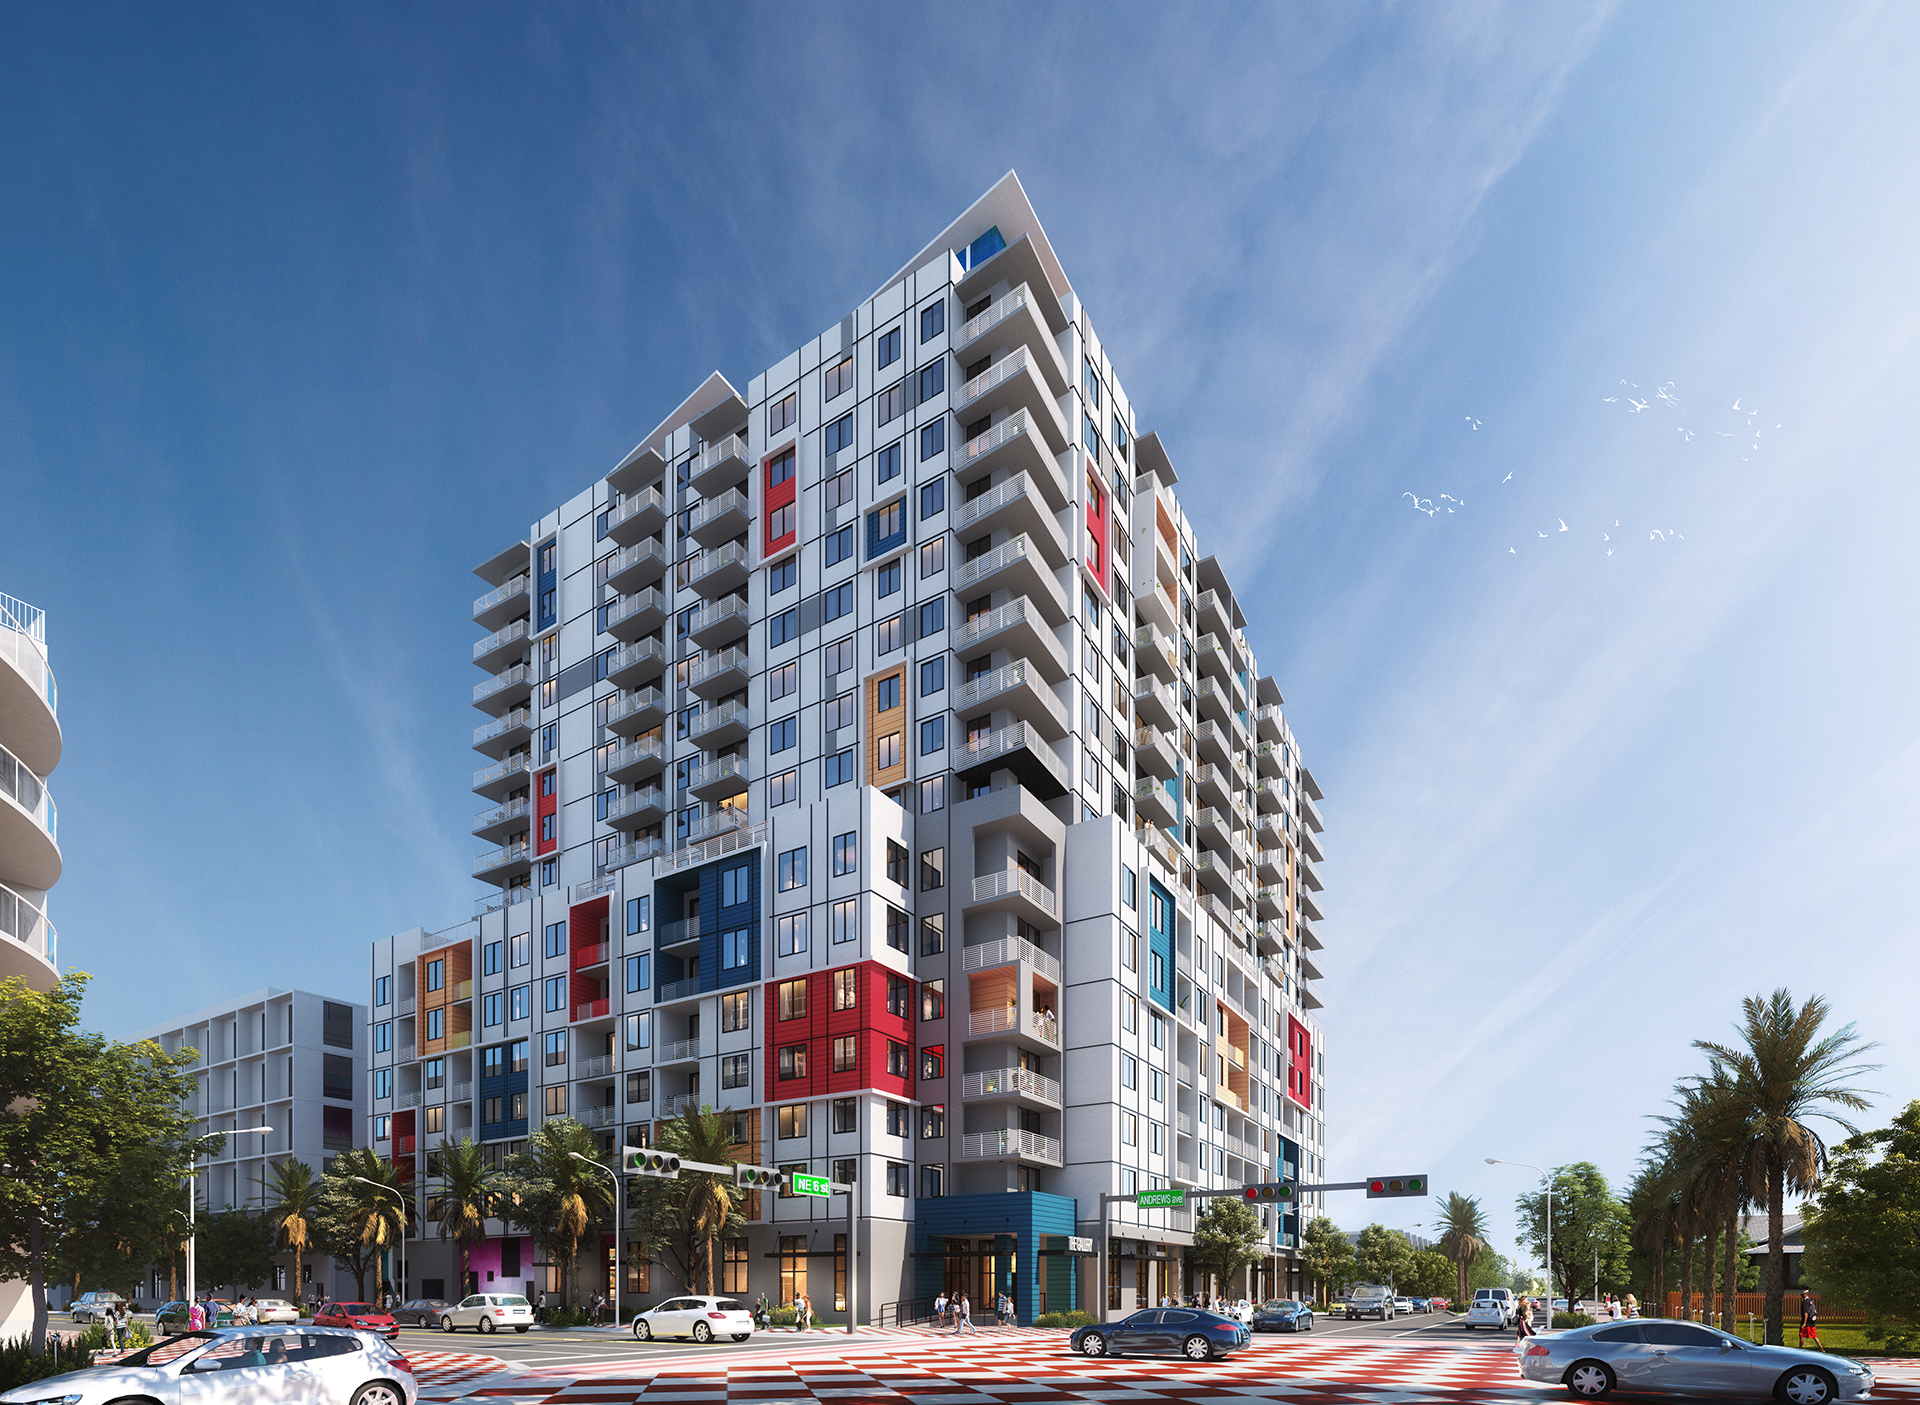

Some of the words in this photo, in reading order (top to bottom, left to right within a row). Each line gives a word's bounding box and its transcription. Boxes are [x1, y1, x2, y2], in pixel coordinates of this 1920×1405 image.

[798, 1178, 812, 1191] NE
[812, 1181, 819, 1192] 6
[1139, 1194, 1171, 1205] ANDREWS
[1172, 1196, 1182, 1204] ave
